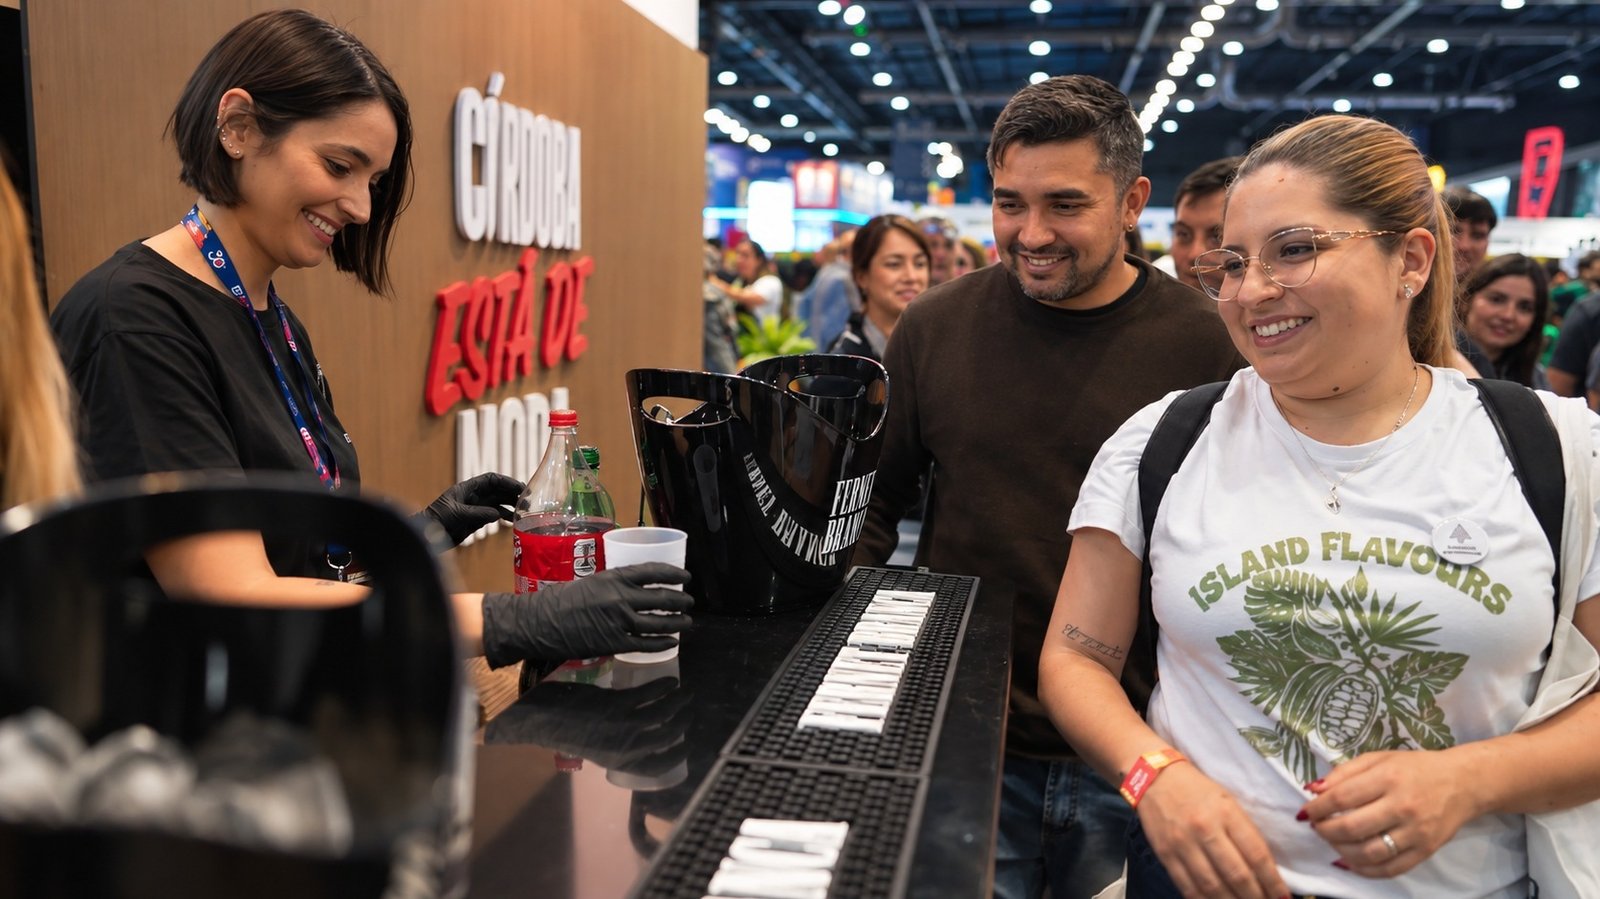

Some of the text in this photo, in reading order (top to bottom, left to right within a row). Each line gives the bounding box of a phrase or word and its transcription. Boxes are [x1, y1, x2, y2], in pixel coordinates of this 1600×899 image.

[425, 247, 596, 416] ESTÁ DE
[456, 387, 569, 546] MOD
[1188, 531, 1513, 615] ISLAND FLAVOURS
